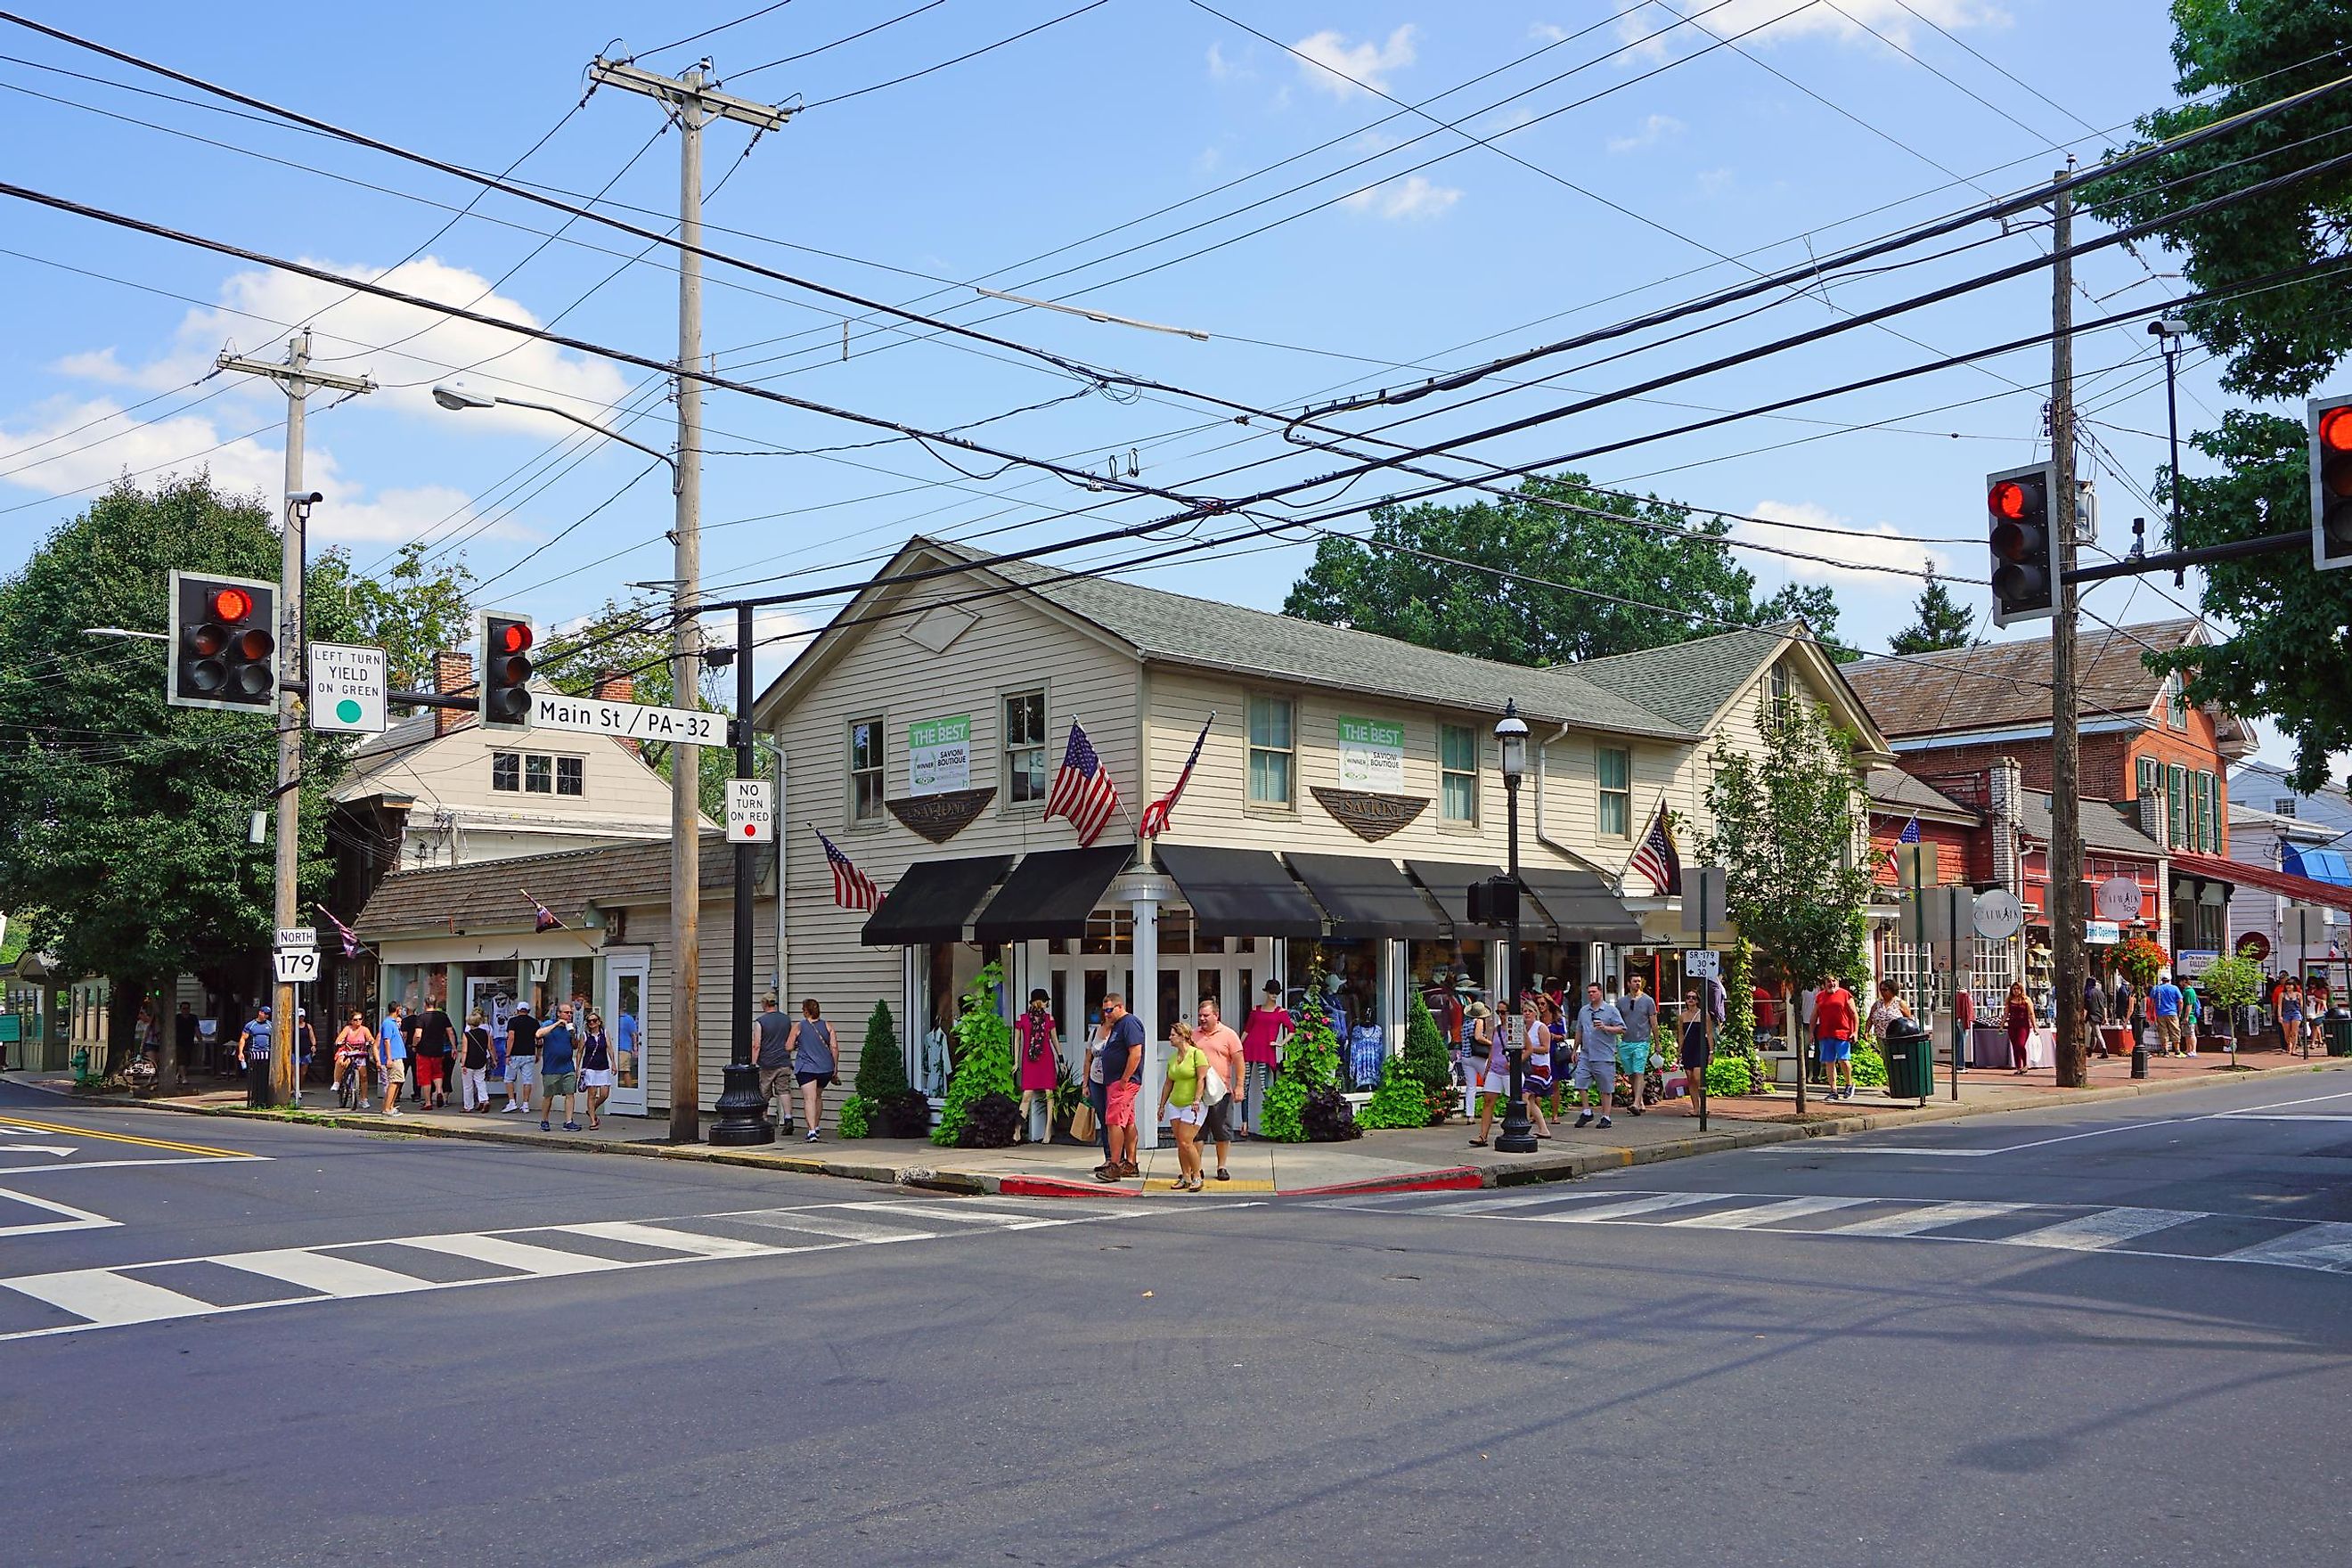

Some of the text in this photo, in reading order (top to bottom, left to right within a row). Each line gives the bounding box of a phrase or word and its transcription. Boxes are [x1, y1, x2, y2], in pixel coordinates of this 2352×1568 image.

[314, 649, 380, 665] LEFT TURN
[329, 666, 368, 682] YIELD
[318, 682, 379, 697] ON GREEN
[540, 700, 591, 724] Main
[600, 707, 620, 728] St
[648, 713, 710, 738] PA-32
[913, 723, 966, 746] THE BEST
[1343, 723, 1400, 746] THE BEST
[940, 748, 964, 758] SAVIONI
[1373, 751, 1398, 761] SAVIONI
[937, 755, 966, 766] BOUTIQUE
[1370, 758, 1400, 769] BOUTIQUE
[739, 784, 759, 796] NO
[737, 798, 764, 809] TURN
[1344, 800, 1401, 817] SAVIONI
[731, 811, 769, 821] ON RED
[281, 931, 314, 943] NORTH
[1689, 951, 1699, 960] SR
[280, 954, 314, 975] 179
[1696, 960, 1707, 968] 30
[1696, 968, 1707, 976] 30
